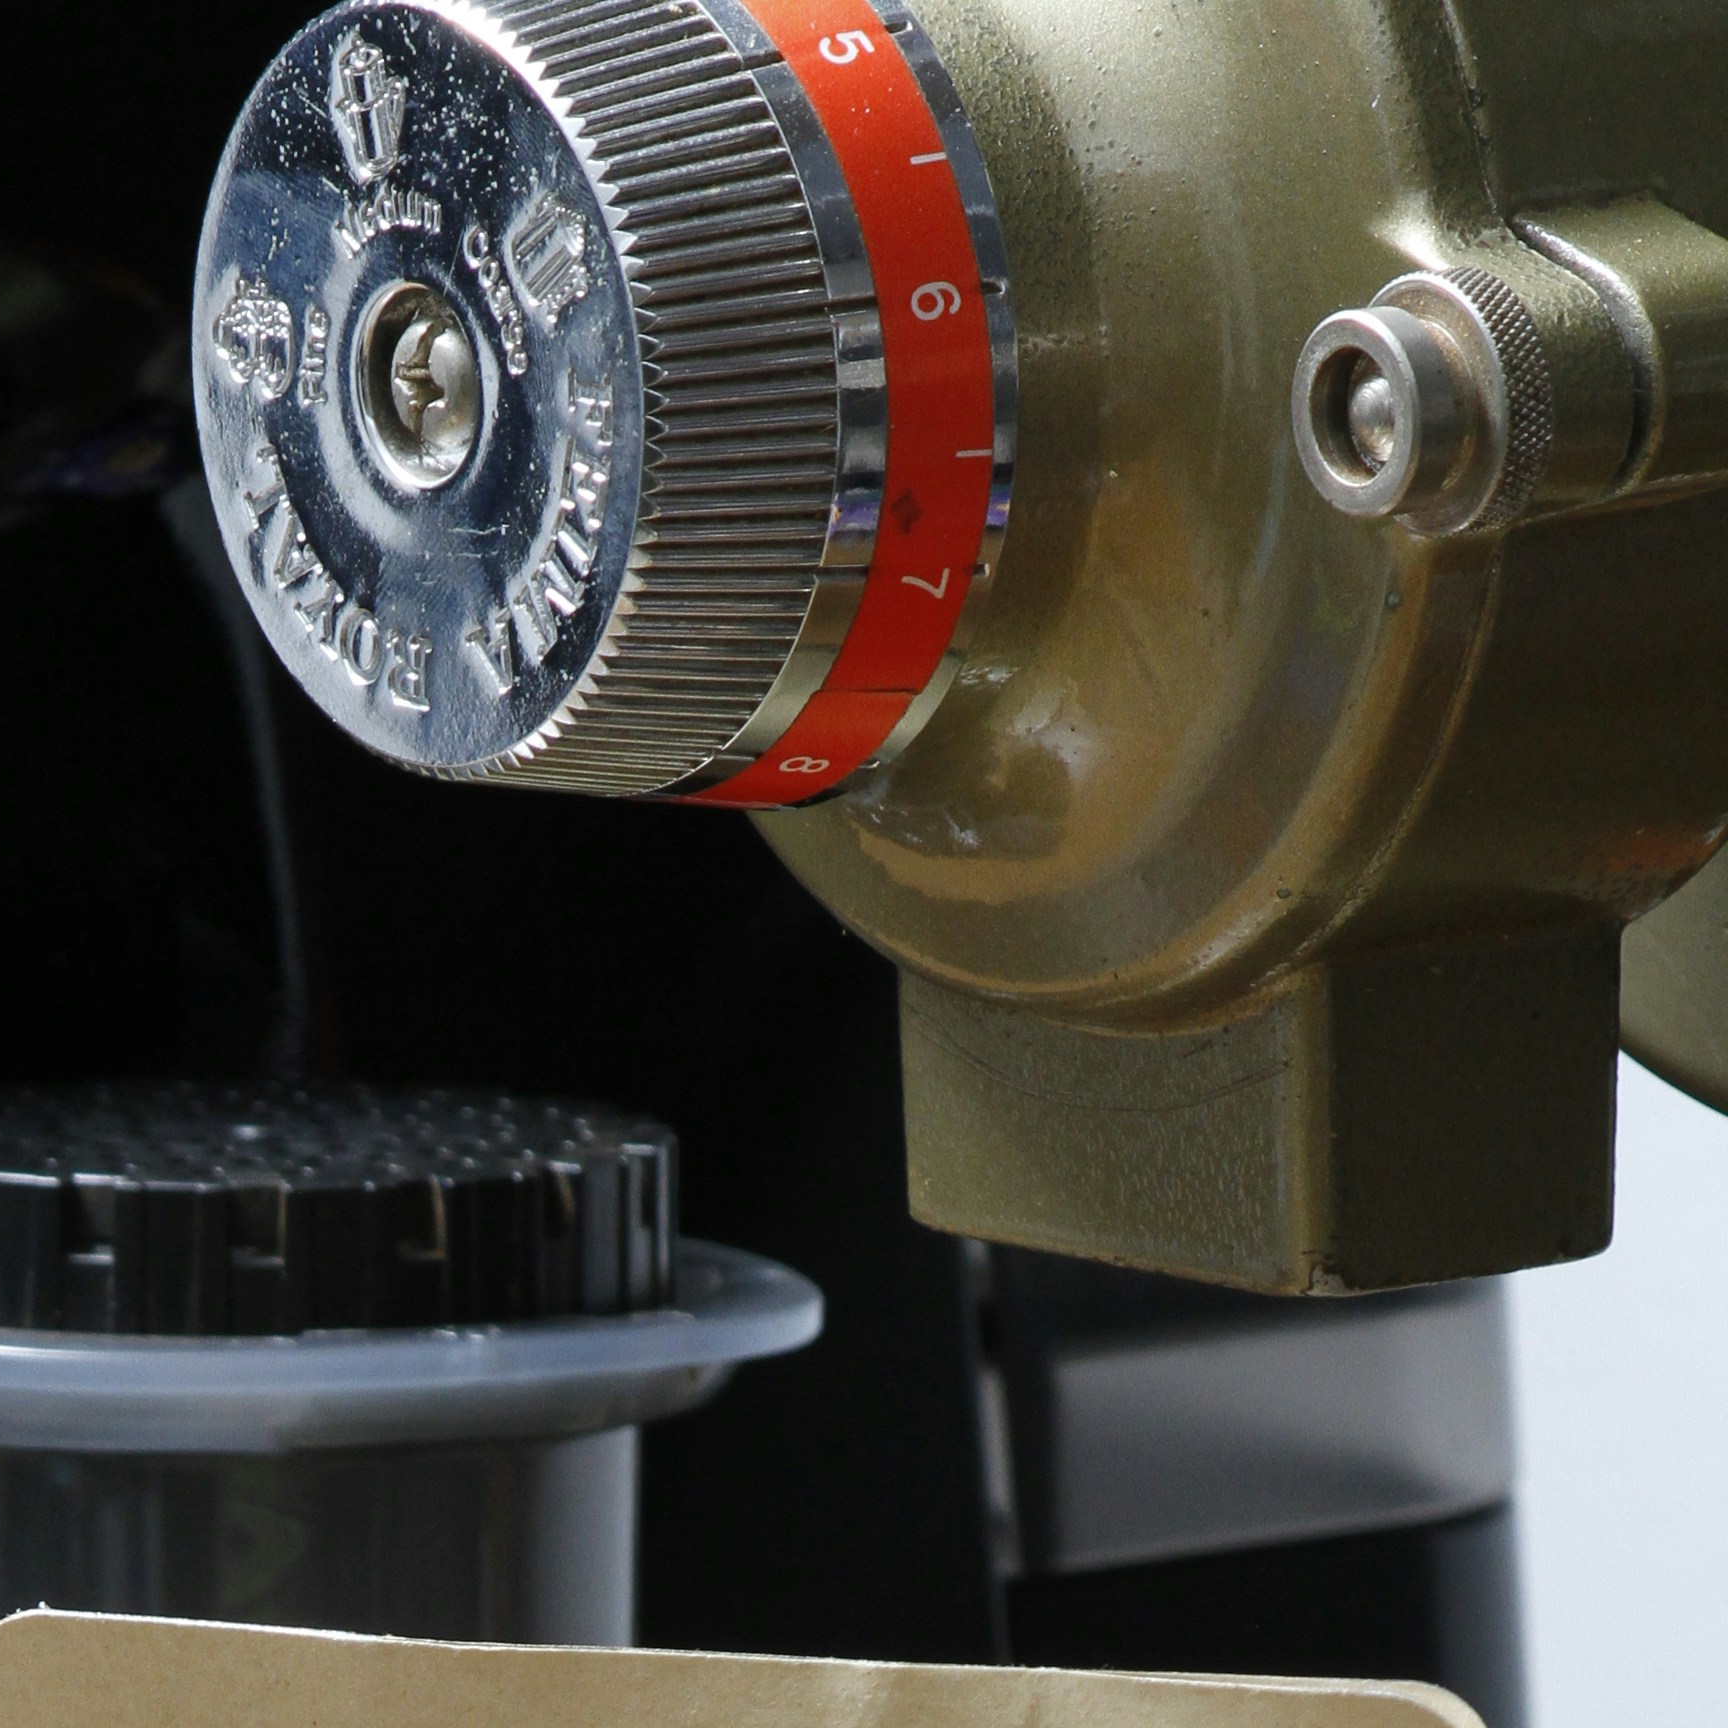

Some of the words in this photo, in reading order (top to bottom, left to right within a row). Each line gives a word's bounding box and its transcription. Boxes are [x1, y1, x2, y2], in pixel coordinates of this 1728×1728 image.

[818, 29, 876, 66] 5
[334, 187, 443, 260] Medium
[909, 280, 963, 322] 6
[298, 305, 332, 405] Fine
[243, 443, 433, 713] ROYAL
[900, 566, 951, 601] 7
[778, 755, 831, 777] 8
